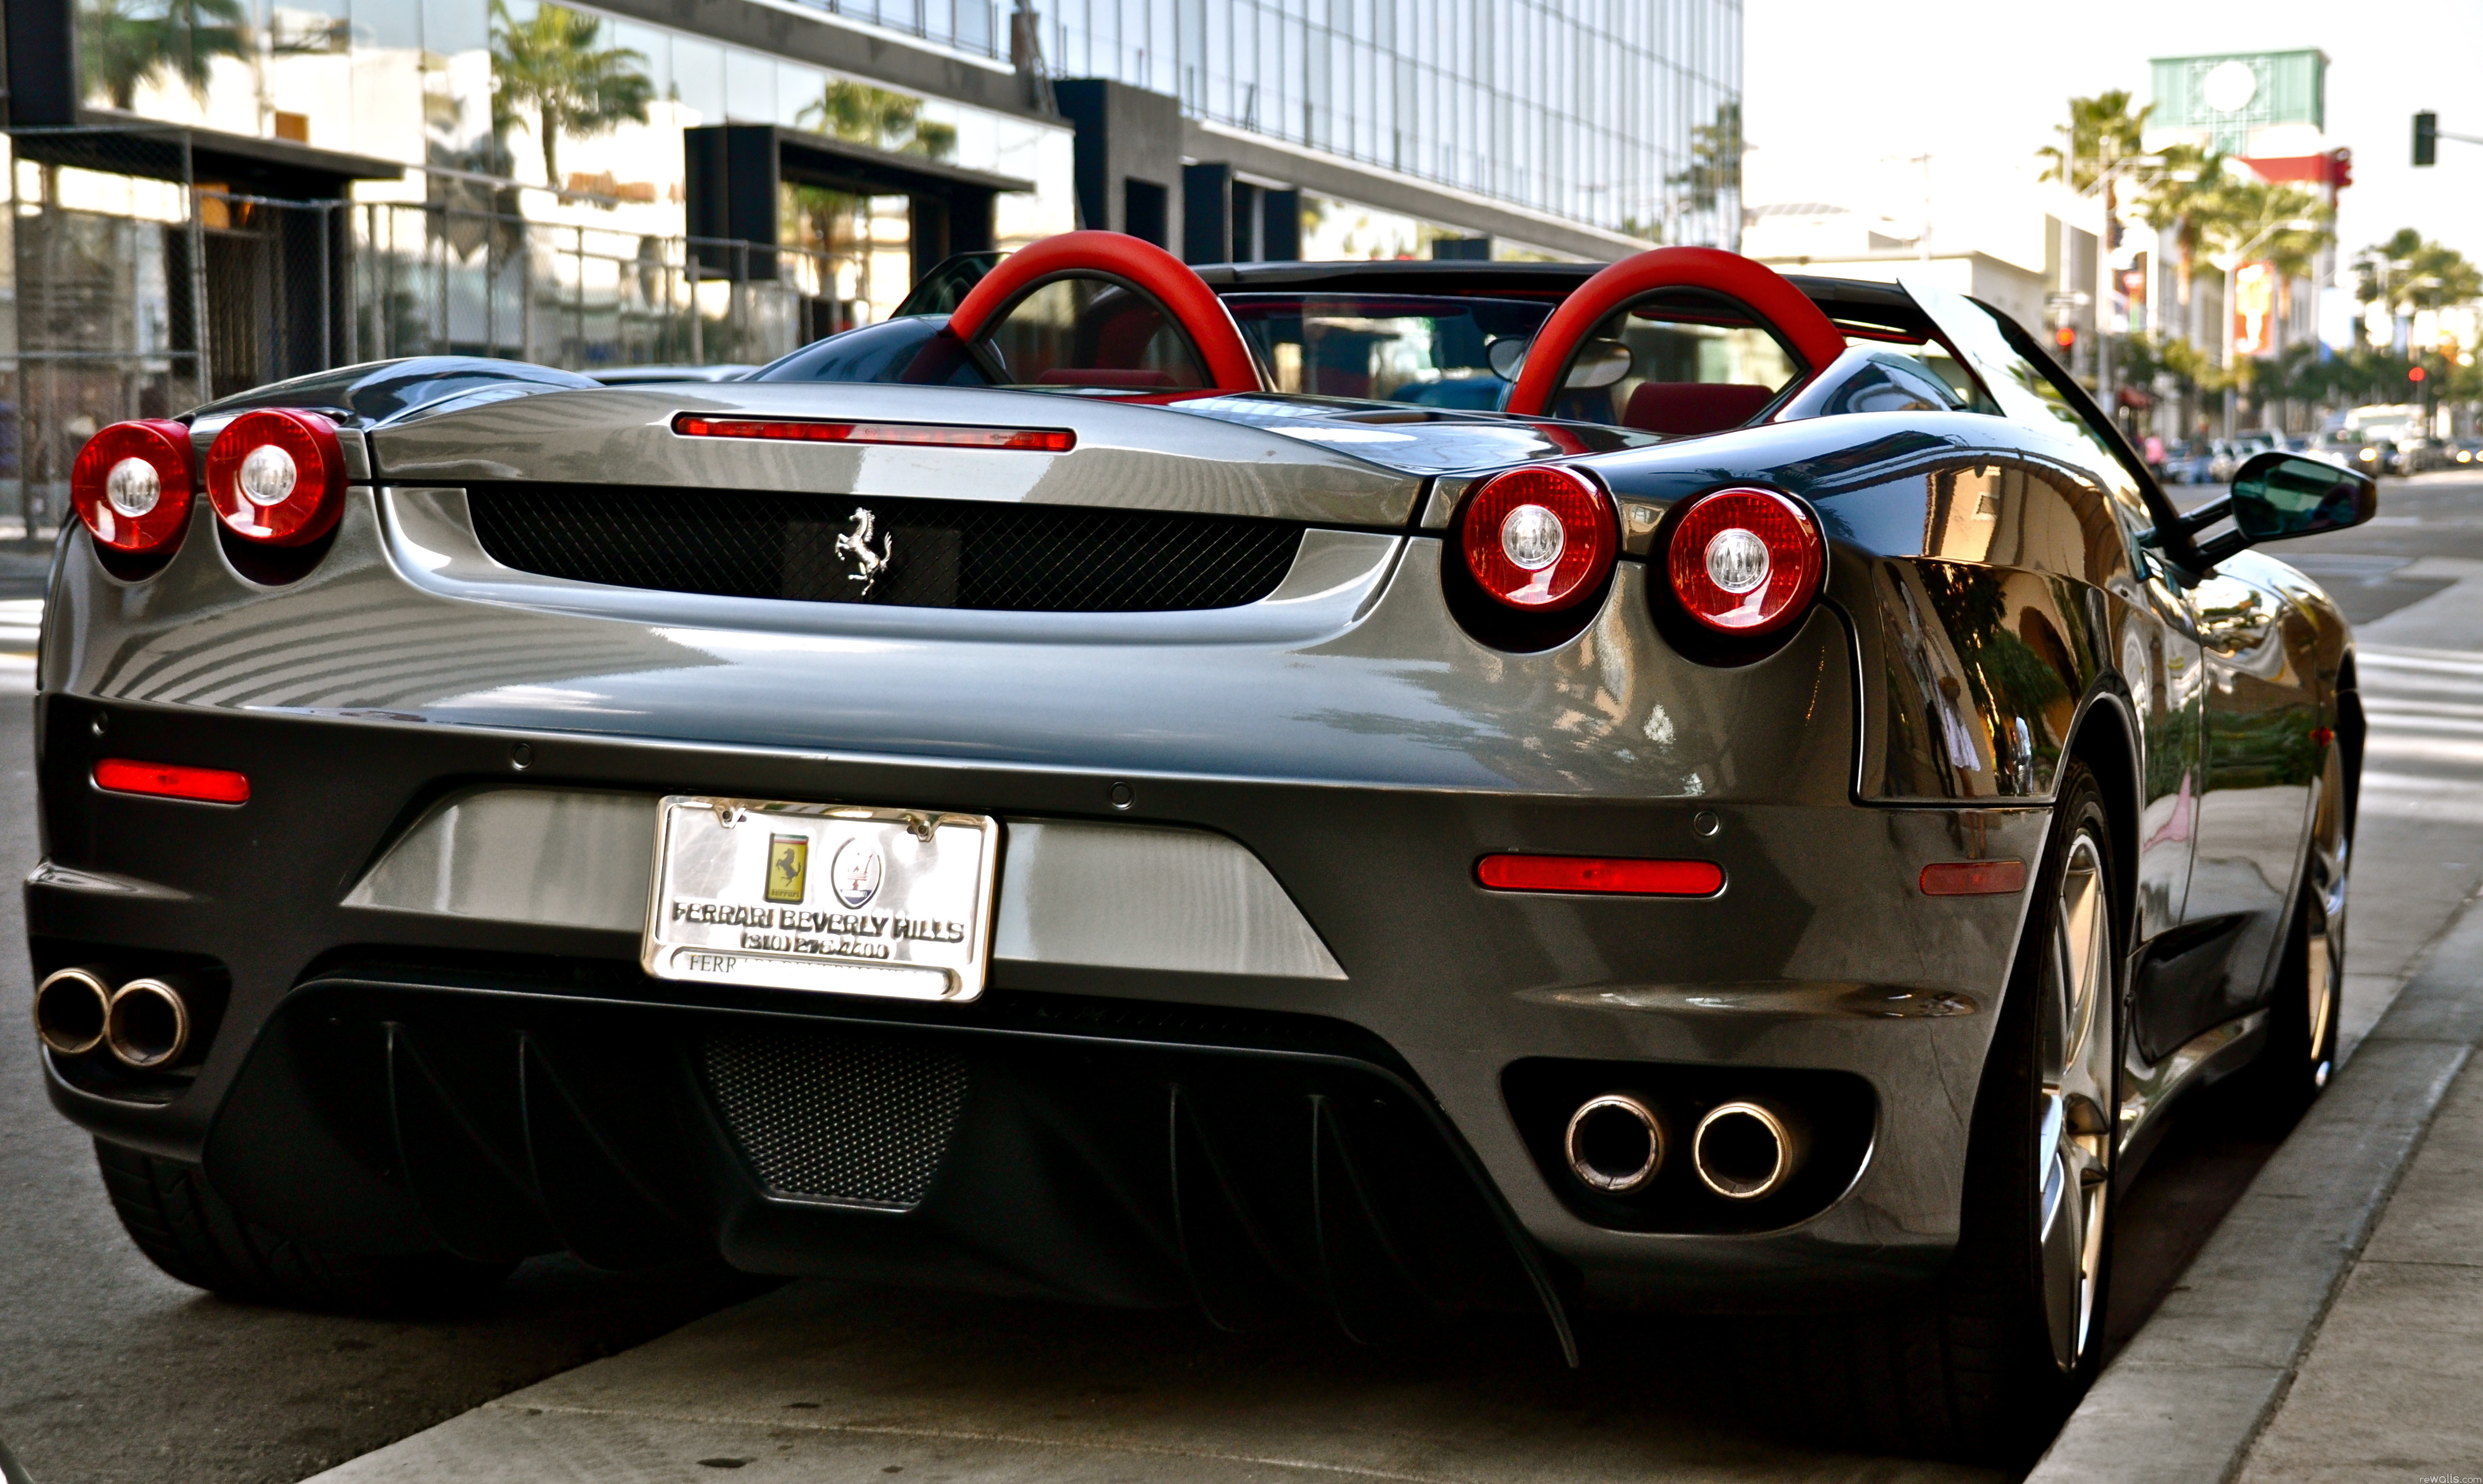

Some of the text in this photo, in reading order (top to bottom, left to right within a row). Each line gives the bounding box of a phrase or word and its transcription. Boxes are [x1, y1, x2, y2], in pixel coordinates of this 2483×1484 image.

[771, 889, 800, 897] Ferrari
[672, 900, 965, 943] FERRARI BEVERLY HILLS
